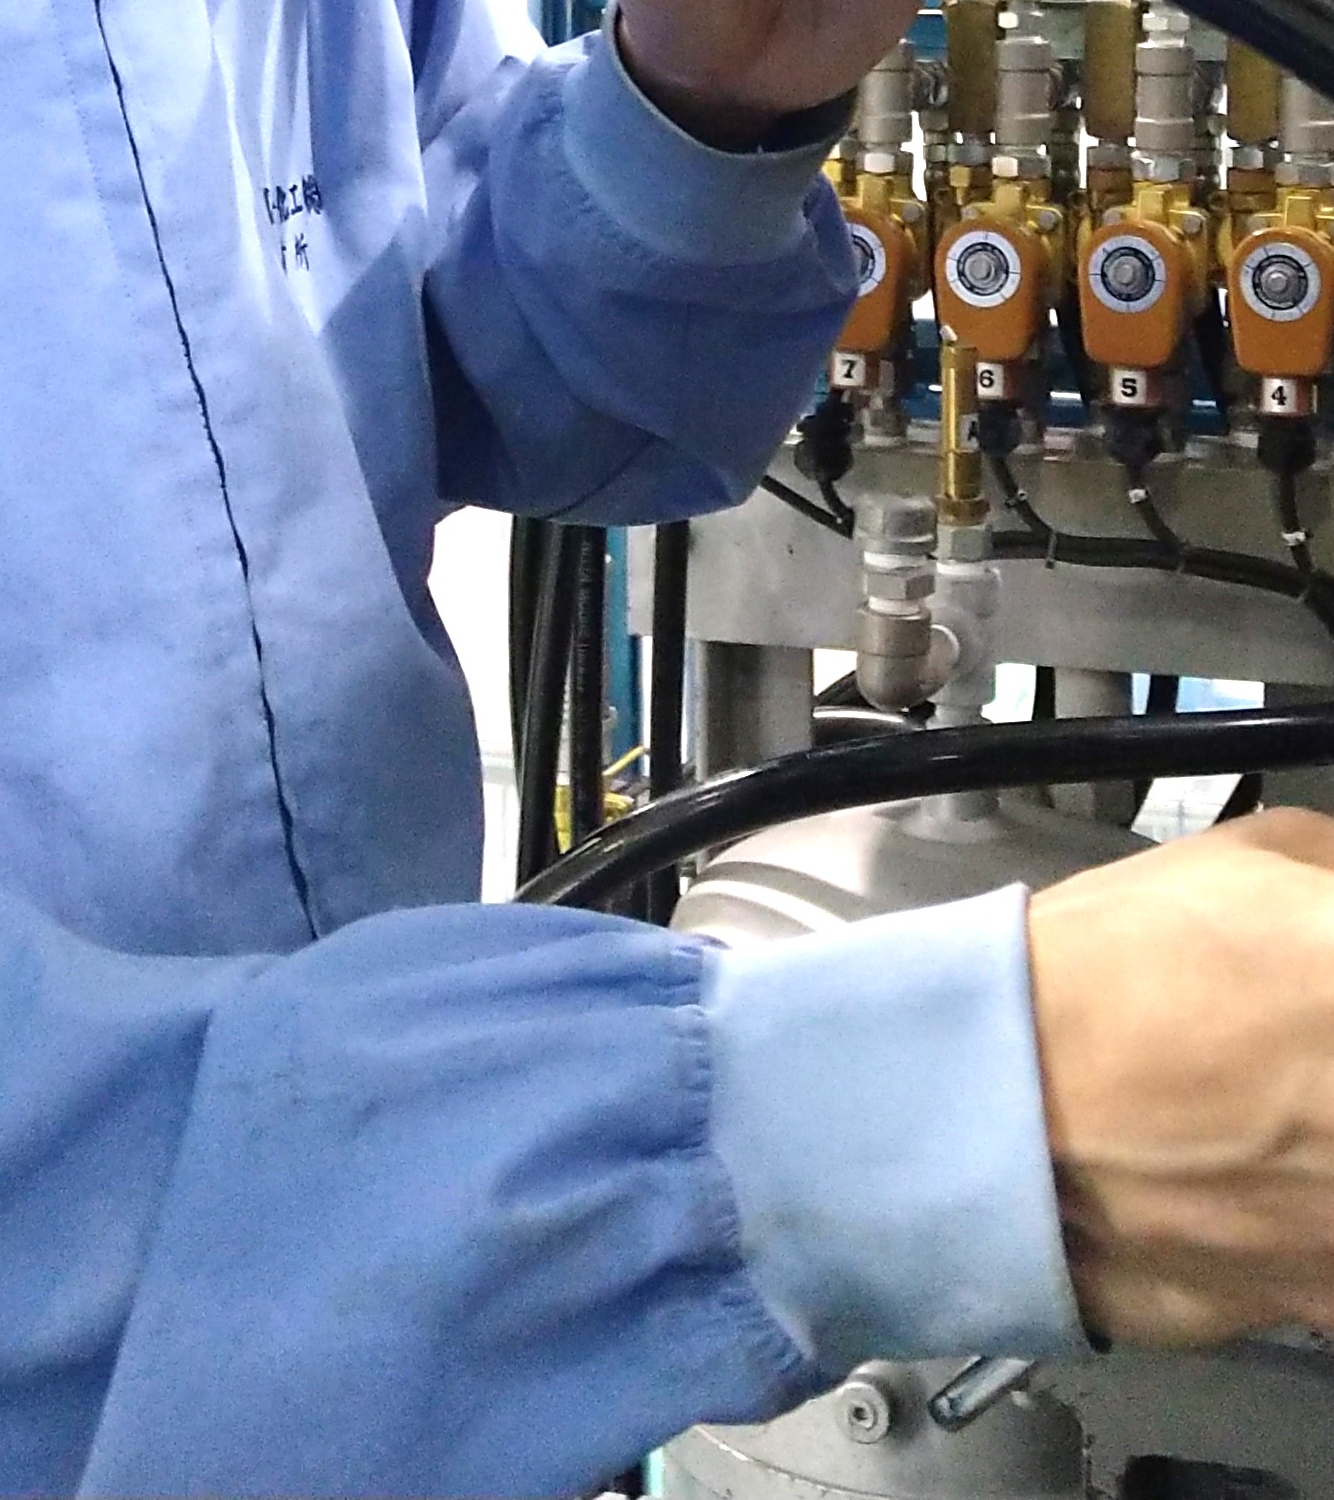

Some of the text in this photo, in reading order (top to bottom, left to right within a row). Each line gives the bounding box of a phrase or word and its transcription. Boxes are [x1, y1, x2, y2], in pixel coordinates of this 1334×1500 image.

[841, 359, 857, 380] 7
[979, 369, 995, 389] 6
[1120, 377, 1138, 398] 5
[1270, 385, 1287, 407] 4
